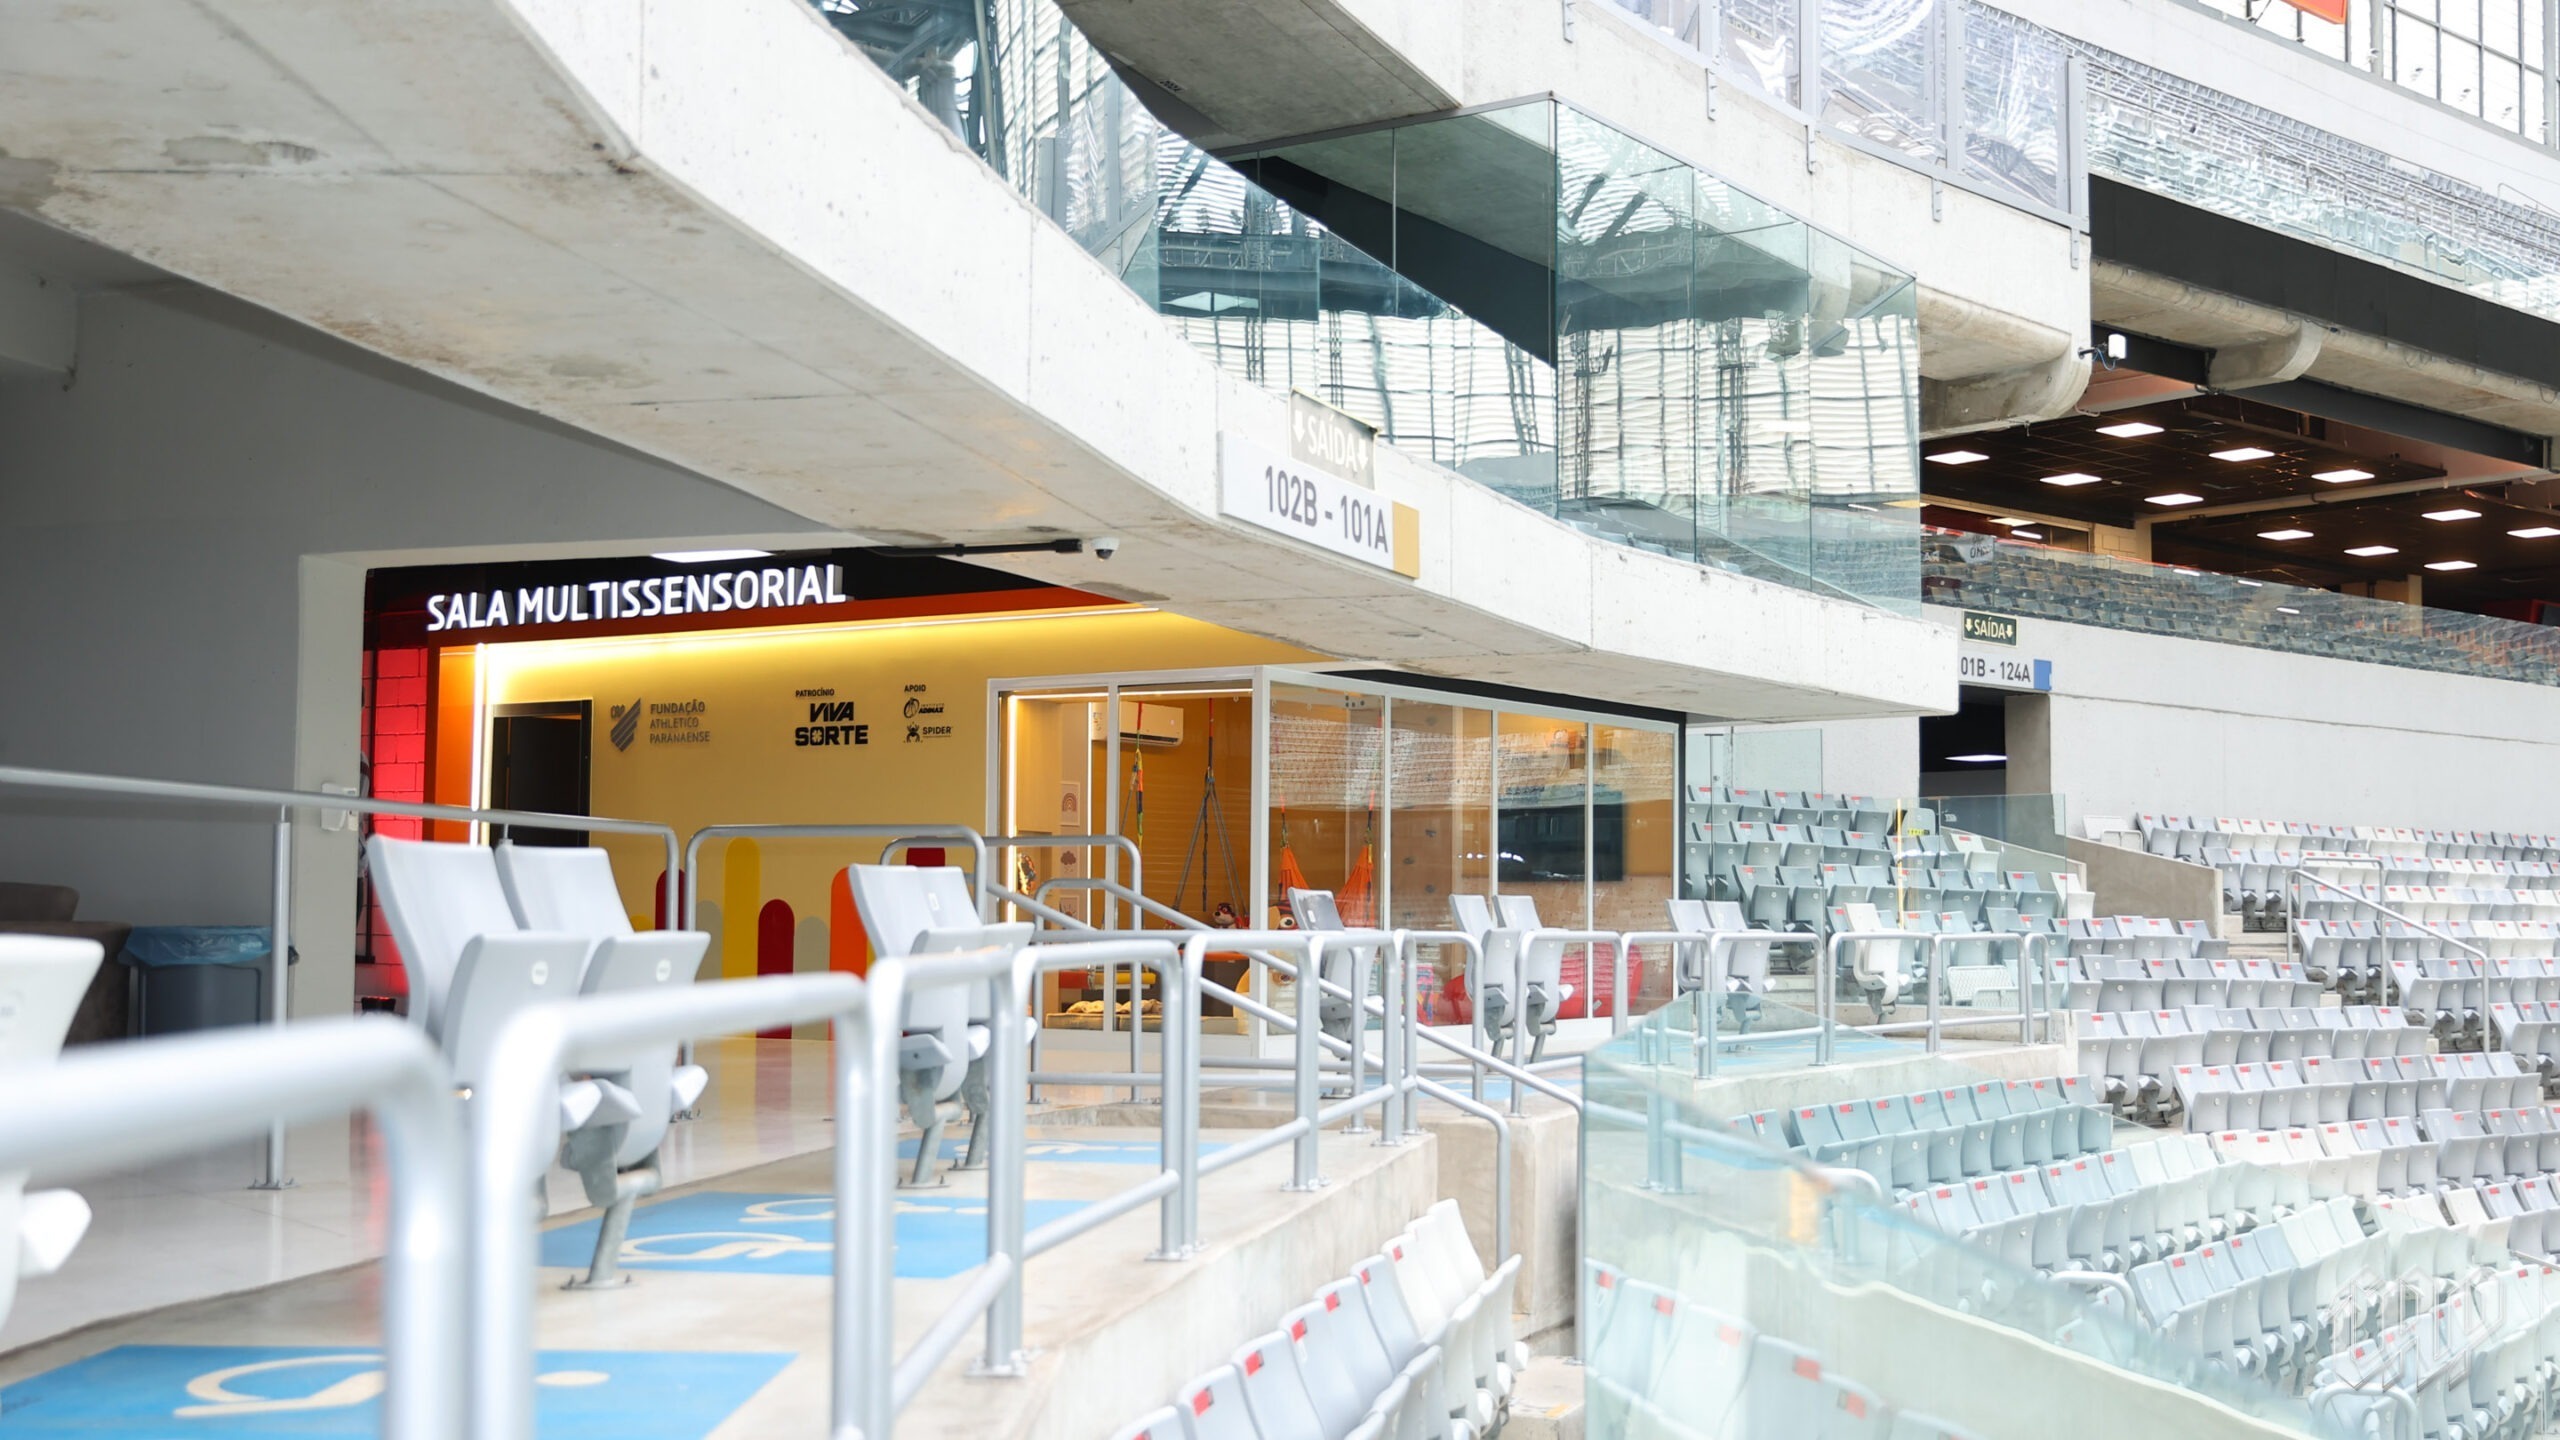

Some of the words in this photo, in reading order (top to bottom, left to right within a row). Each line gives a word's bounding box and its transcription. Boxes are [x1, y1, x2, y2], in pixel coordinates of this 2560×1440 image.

[1307, 414, 1359, 472] SAÍDA
[1265, 464, 1318, 528] 102B
[1340, 495, 1389, 553] 101A
[427, 590, 509, 632] SALA
[517, 563, 847, 625] MULTISSENSORIAL
[1973, 616, 2007, 640] SAÍDA
[1999, 661, 2031, 683] 124A
[795, 687, 835, 698] PATROCÍNIO
[904, 684, 927, 693] APOIO
[650, 699, 706, 715] FUNDAÇÃO
[809, 701, 855, 723] VIVA
[650, 717, 699, 729] ATHLETICO
[922, 726, 952, 735] SPIDER
[650, 731, 711, 744] PARANAENSE
[795, 725, 869, 747] SORTE
